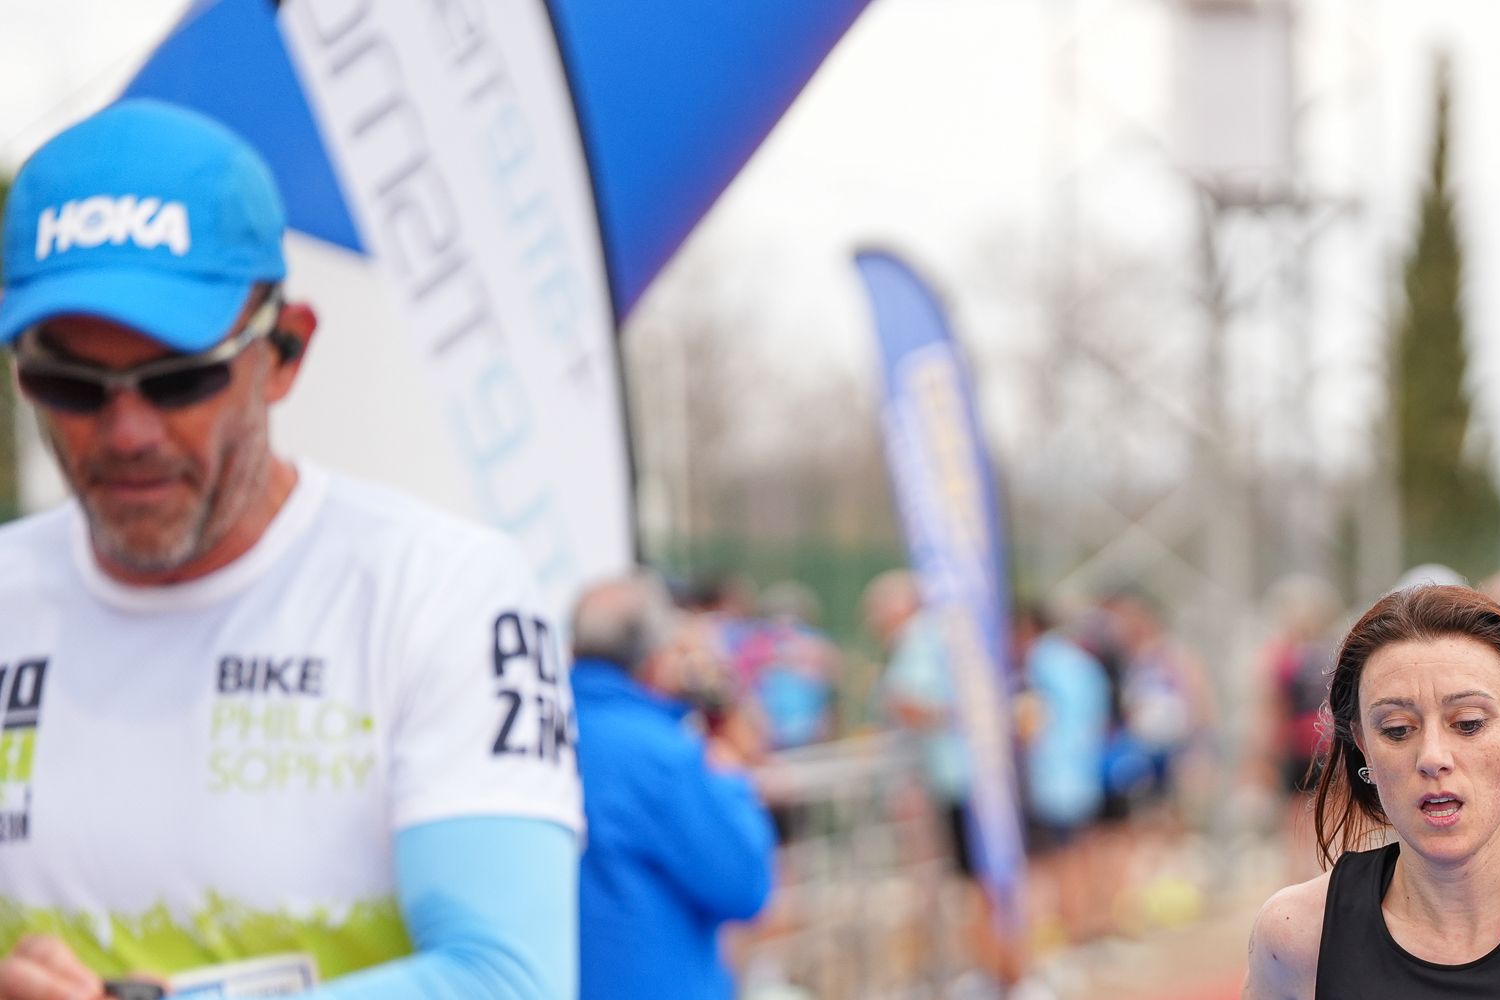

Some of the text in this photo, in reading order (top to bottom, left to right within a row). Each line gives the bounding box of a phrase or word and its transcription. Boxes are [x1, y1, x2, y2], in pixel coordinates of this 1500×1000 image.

[35, 195, 190, 262] HOKA
[216, 654, 326, 696] BIKE
[207, 748, 377, 794] SOPHY
